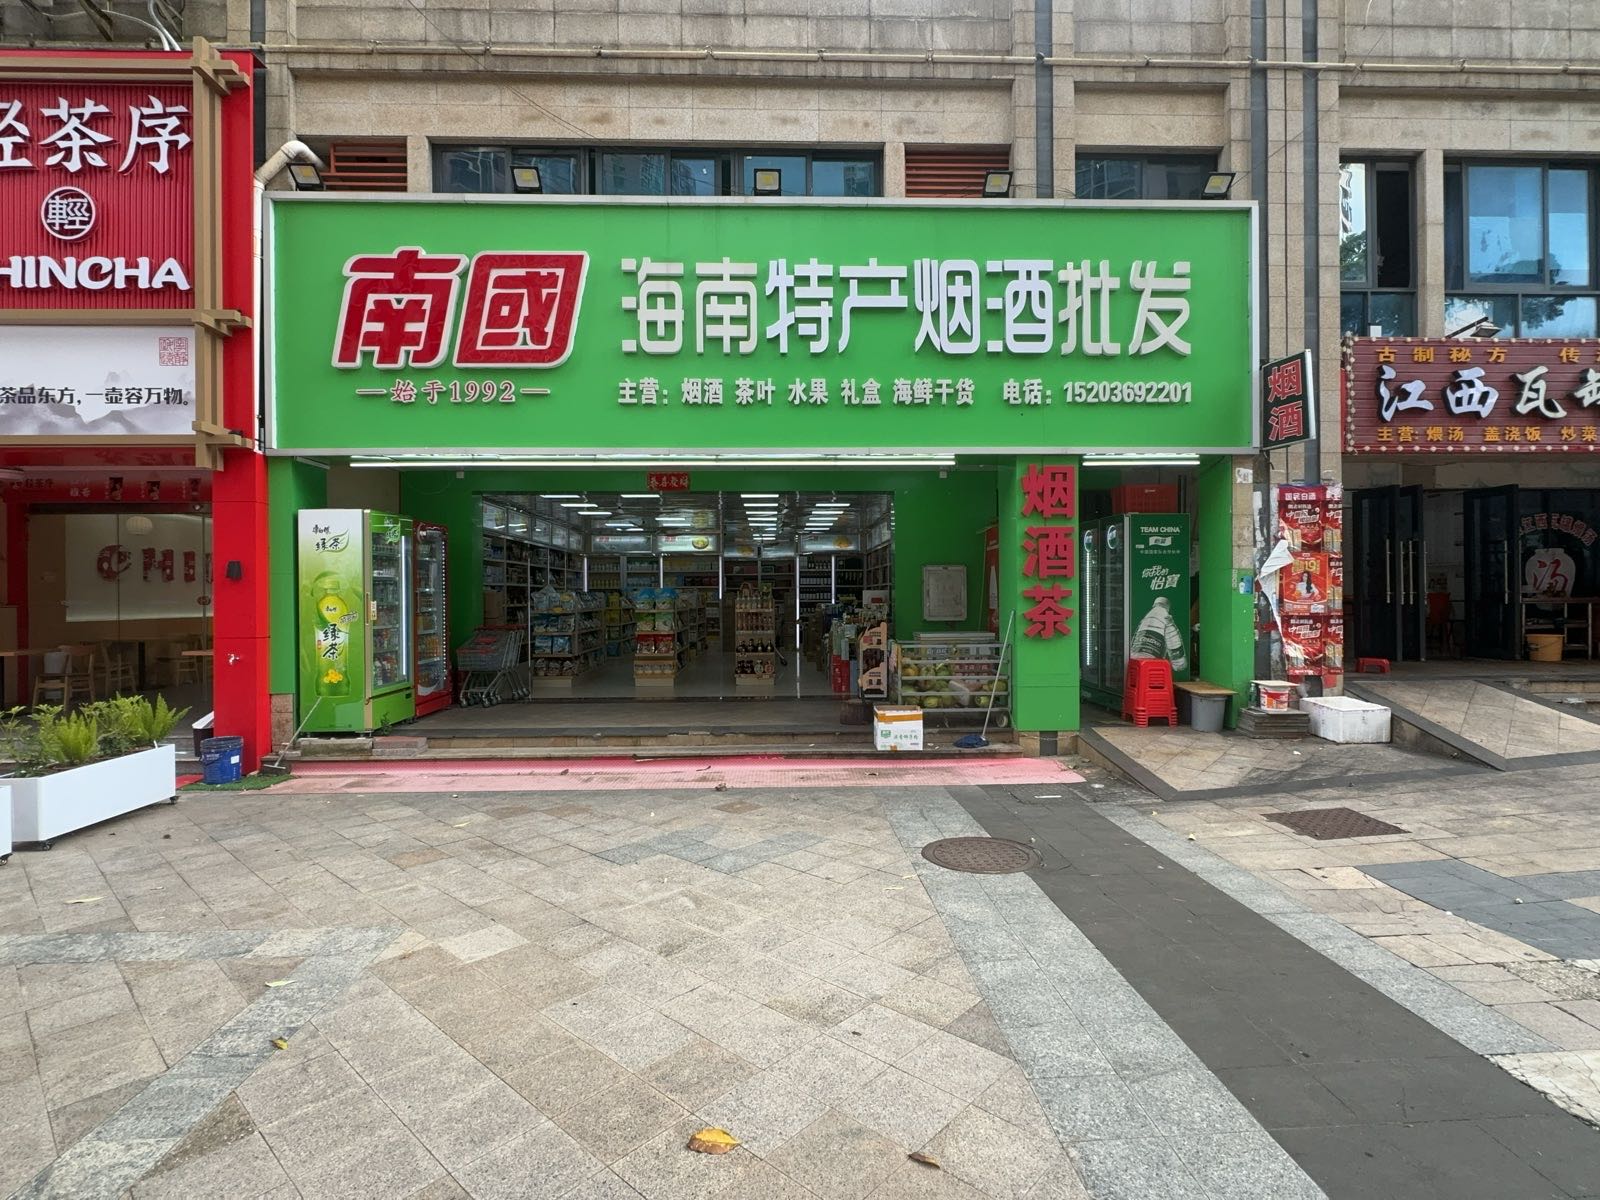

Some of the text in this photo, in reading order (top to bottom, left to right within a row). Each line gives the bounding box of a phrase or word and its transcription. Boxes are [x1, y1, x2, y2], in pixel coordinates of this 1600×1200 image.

[47, 195, 90, 231] 輕
[331, 246, 591, 369] 南國
[621, 256, 1193, 356] 海南特产烟酒批发
[1376, 346, 1600, 363] 古制秘方 传
[681, 377, 723, 405] 烟酒
[734, 378, 777, 405] 茶叶
[787, 378, 829, 405] 水果
[840, 379, 882, 405] 礼盒
[892, 379, 976, 406] 海鲜干货
[1063, 381, 1193, 405] 15203692201
[1268, 359, 1304, 441] 烟酒
[1426, 426, 1465, 442] 煨汤
[1484, 426, 1542, 442] 盖浇饭
[1560, 426, 1598, 442] 炒菜
[1020, 464, 1075, 638] 烟酒茶
